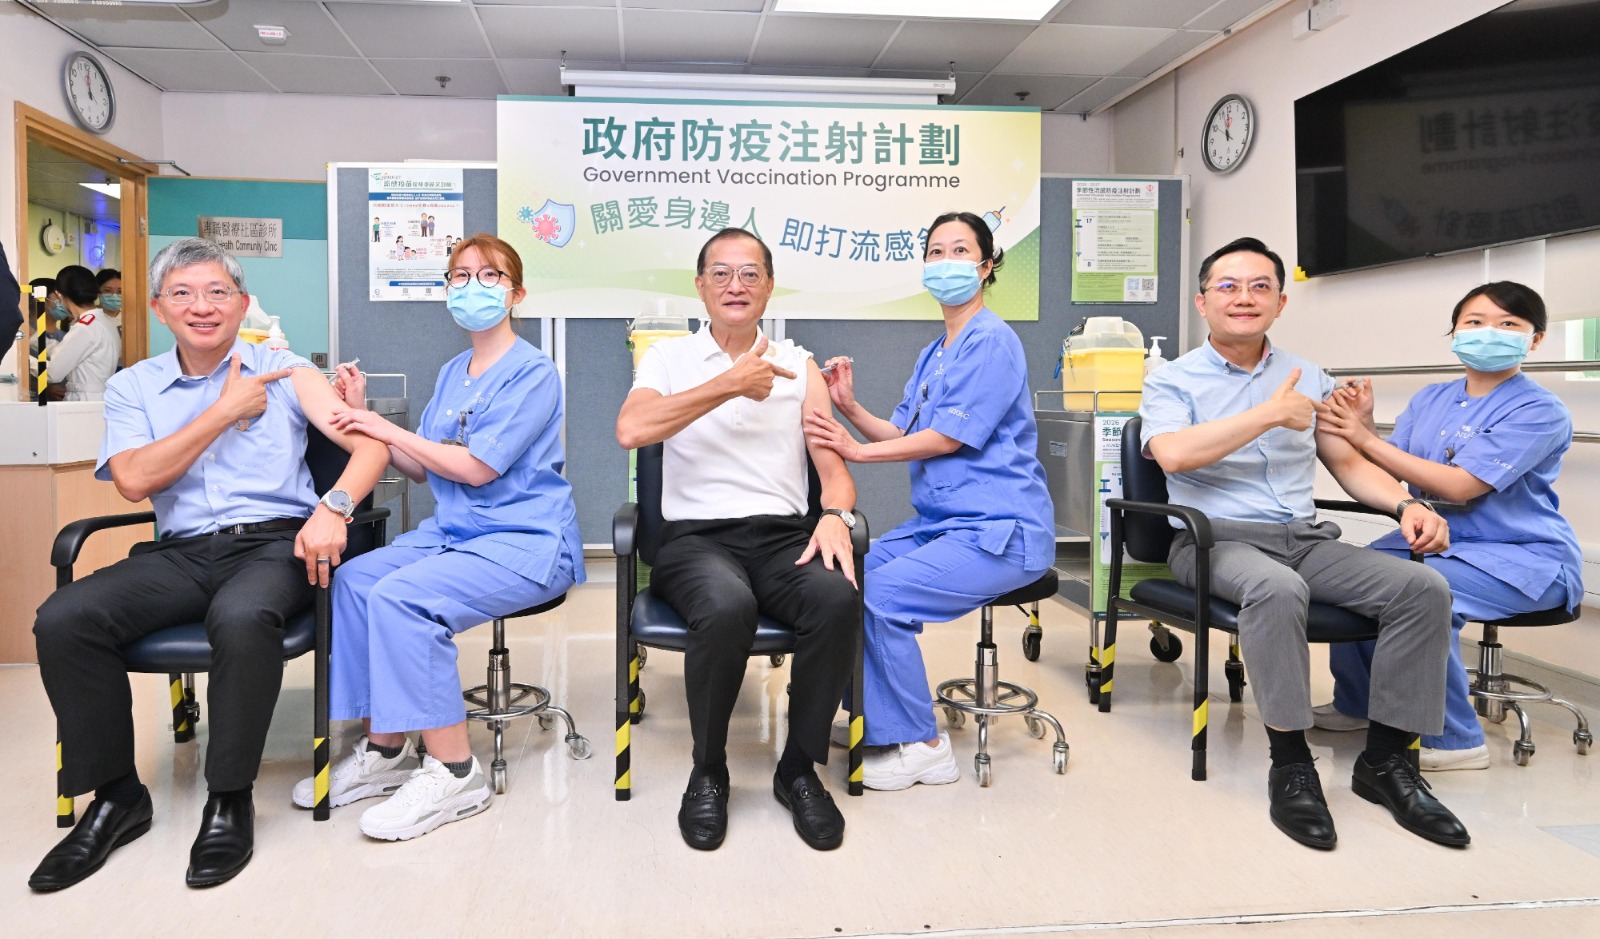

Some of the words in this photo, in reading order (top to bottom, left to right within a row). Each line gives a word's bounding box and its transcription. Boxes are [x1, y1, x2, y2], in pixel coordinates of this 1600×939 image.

[581, 116, 961, 167] 政府防疫注射計劃
[583, 167, 711, 184] Government
[720, 169, 837, 187] Vaccination
[843, 171, 961, 192] Programme
[203, 220, 277, 238] 專職醫療社區診所
[590, 195, 762, 239] 關愛身邊人
[236, 240, 262, 253] Community
[264, 241, 278, 252] Clinic
